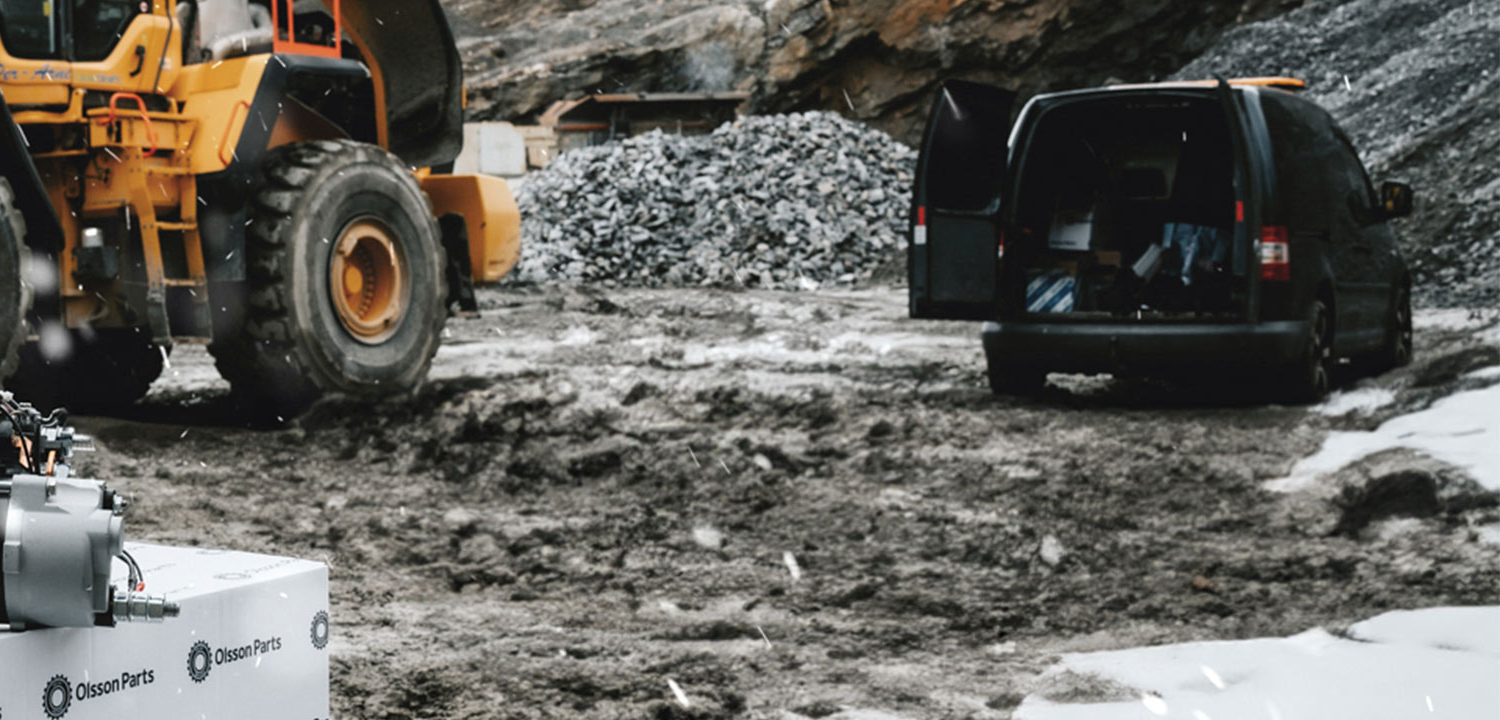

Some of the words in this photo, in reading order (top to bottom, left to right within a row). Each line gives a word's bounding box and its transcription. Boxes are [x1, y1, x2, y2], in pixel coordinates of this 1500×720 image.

[213, 644, 252, 665] Olsson
[253, 636, 282, 656] Parts
[75, 677, 120, 701] Olsson
[121, 668, 155, 690] Parts
